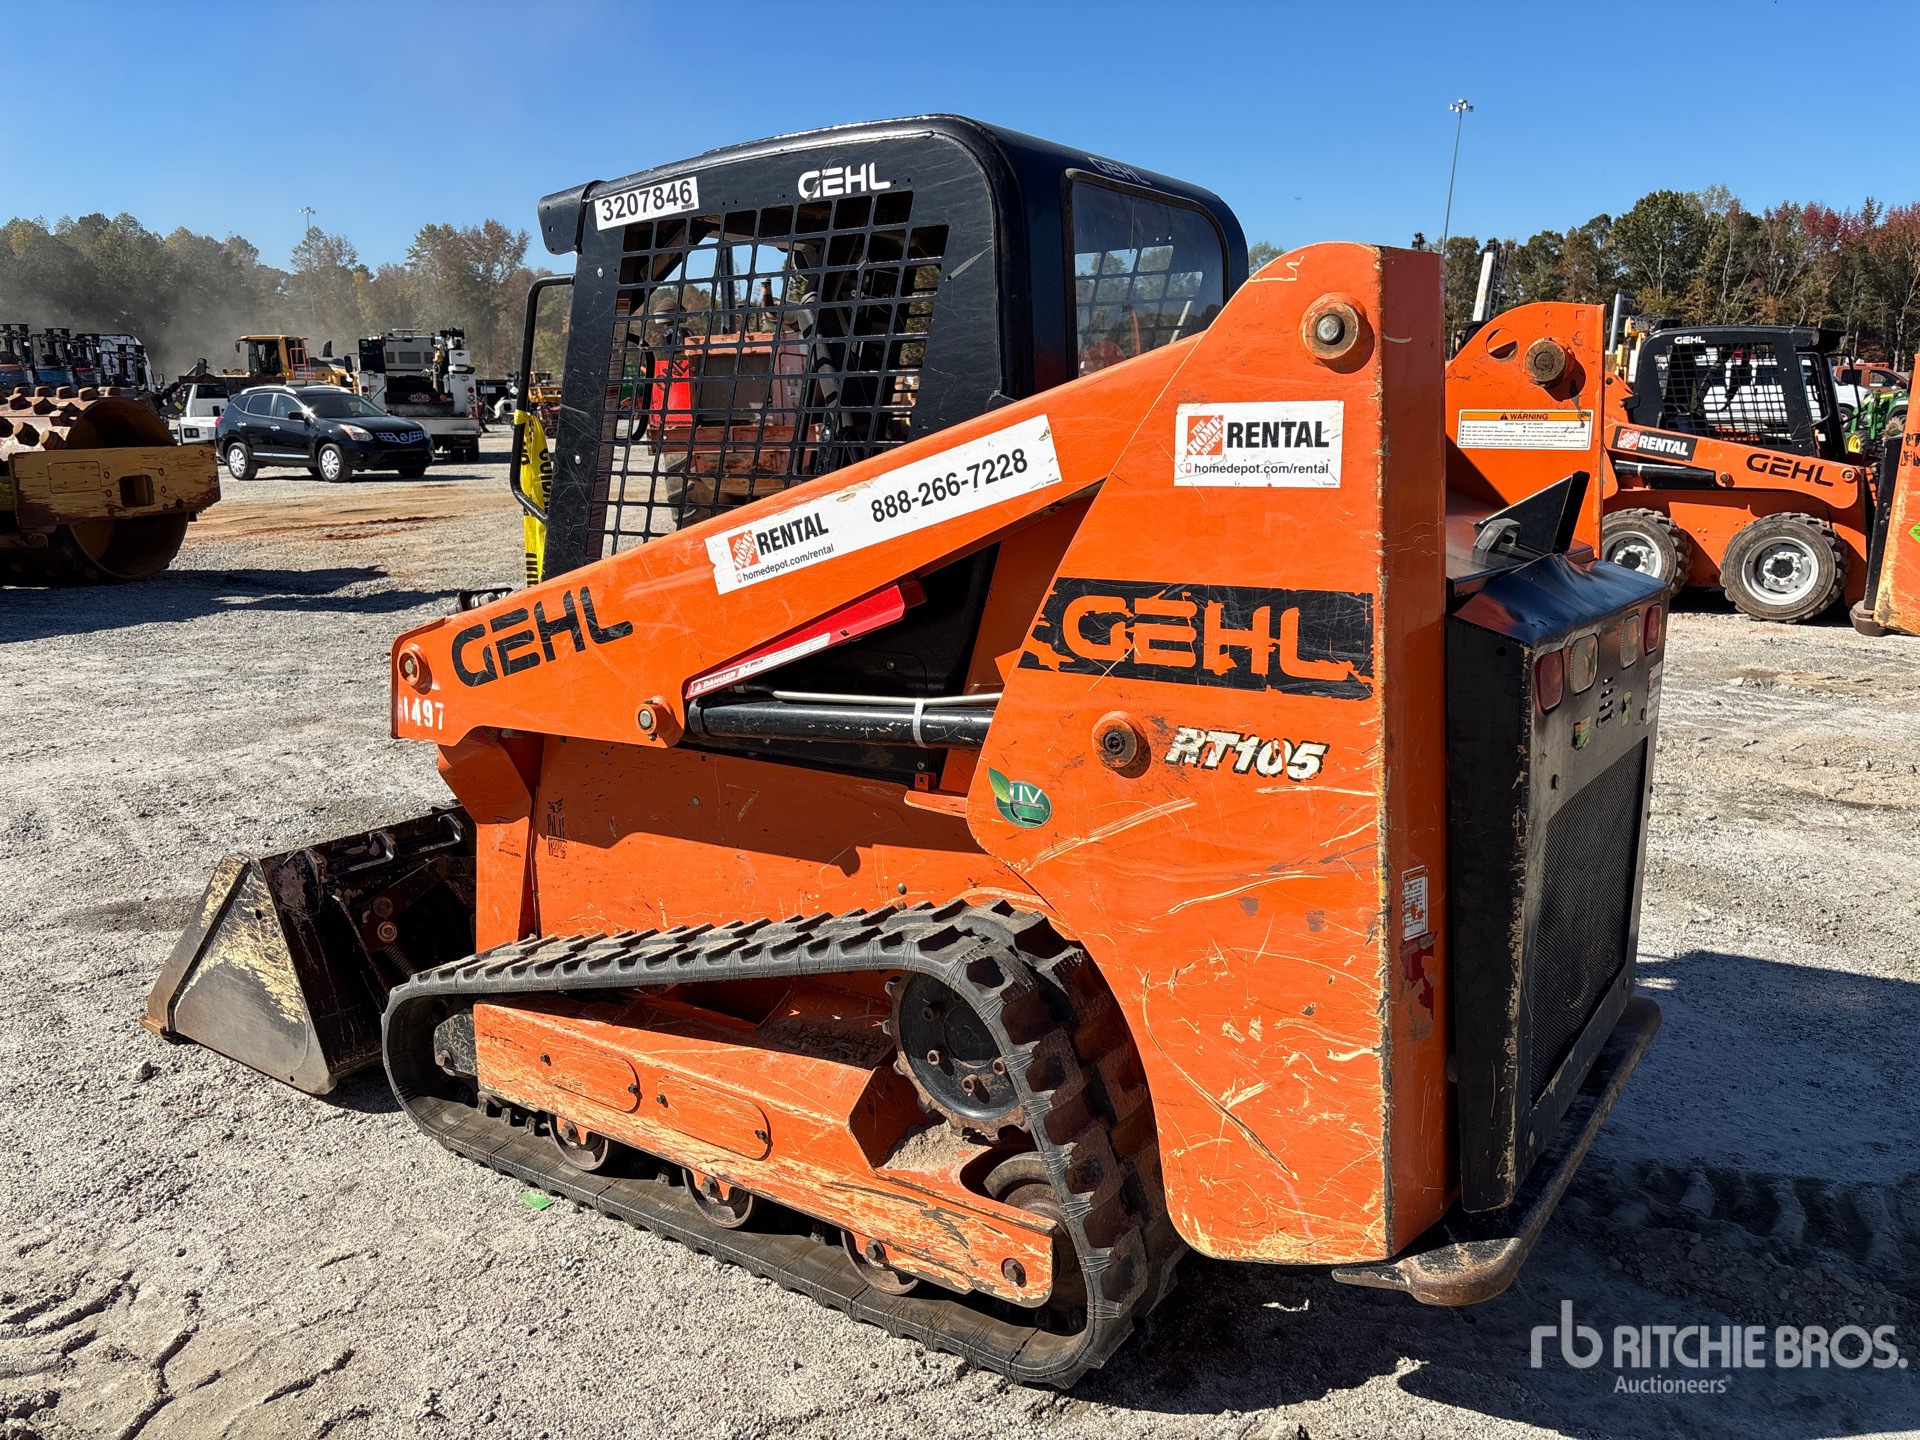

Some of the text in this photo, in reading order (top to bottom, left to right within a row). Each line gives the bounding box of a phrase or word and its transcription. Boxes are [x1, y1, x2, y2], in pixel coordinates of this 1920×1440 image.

[797, 162, 891, 199] GEHL
[1087, 156, 1152, 186] GEHL
[601, 180, 693, 222] 3207846
[1674, 336, 1706, 344] GEHL
[1190, 419, 1208, 437] THE
[1227, 421, 1330, 448] RENTAL
[1510, 413, 1549, 421] WARNING
[1187, 415, 1223, 455] HOME
[1200, 429, 1223, 455] DEPOT
[1638, 435, 1689, 456] RENTAL
[871, 448, 1028, 522] 888-266-7228
[1194, 463, 1329, 475] homedepot.com/rental
[1747, 453, 1834, 487] GEHL
[734, 530, 754, 570] HOME
[756, 512, 830, 556] RENTAL
[743, 543, 835, 581] homedepot.com/rental
[452, 586, 634, 687] GEHL
[1063, 595, 1356, 681] GEHL
[403, 696, 445, 730] 1497
[1164, 726, 1330, 781] RT105
